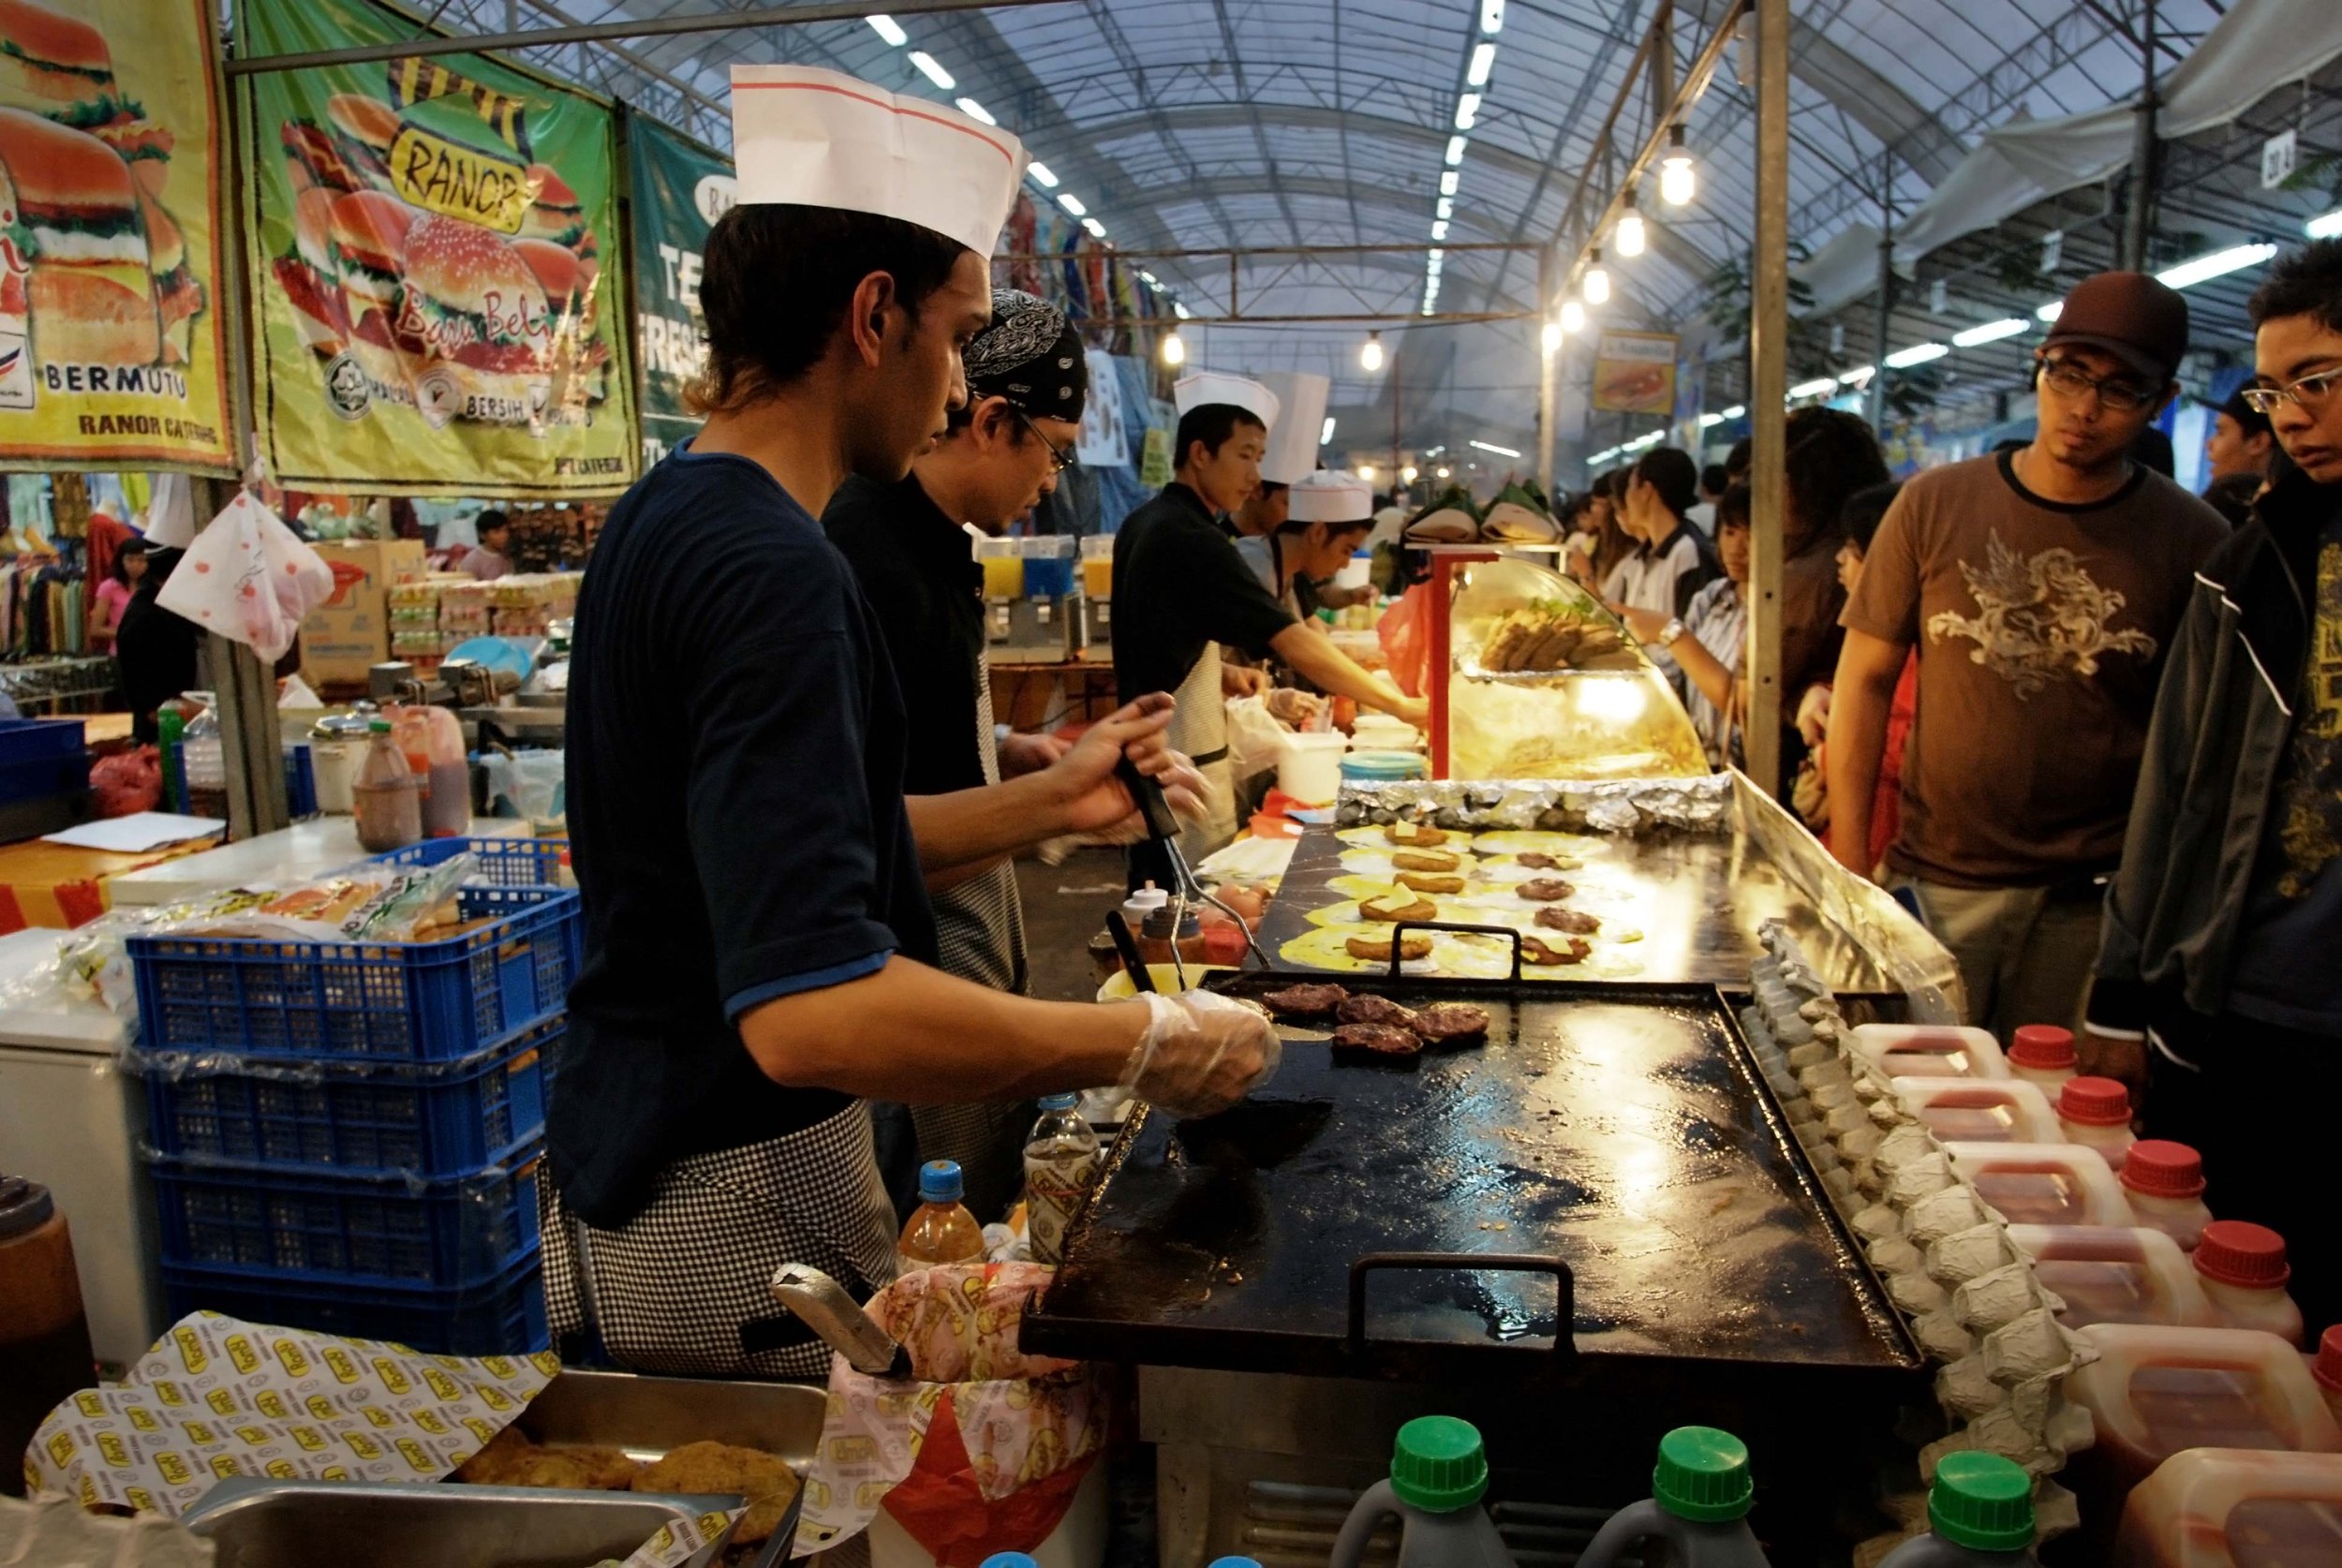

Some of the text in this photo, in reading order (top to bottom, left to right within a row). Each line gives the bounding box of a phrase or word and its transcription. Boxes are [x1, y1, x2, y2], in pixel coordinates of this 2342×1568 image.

[483, 289, 553, 339] Beli
[45, 363, 187, 400] BERMUTU
[466, 394, 525, 419] BERSIH
[79, 414, 161, 436] RANOR
